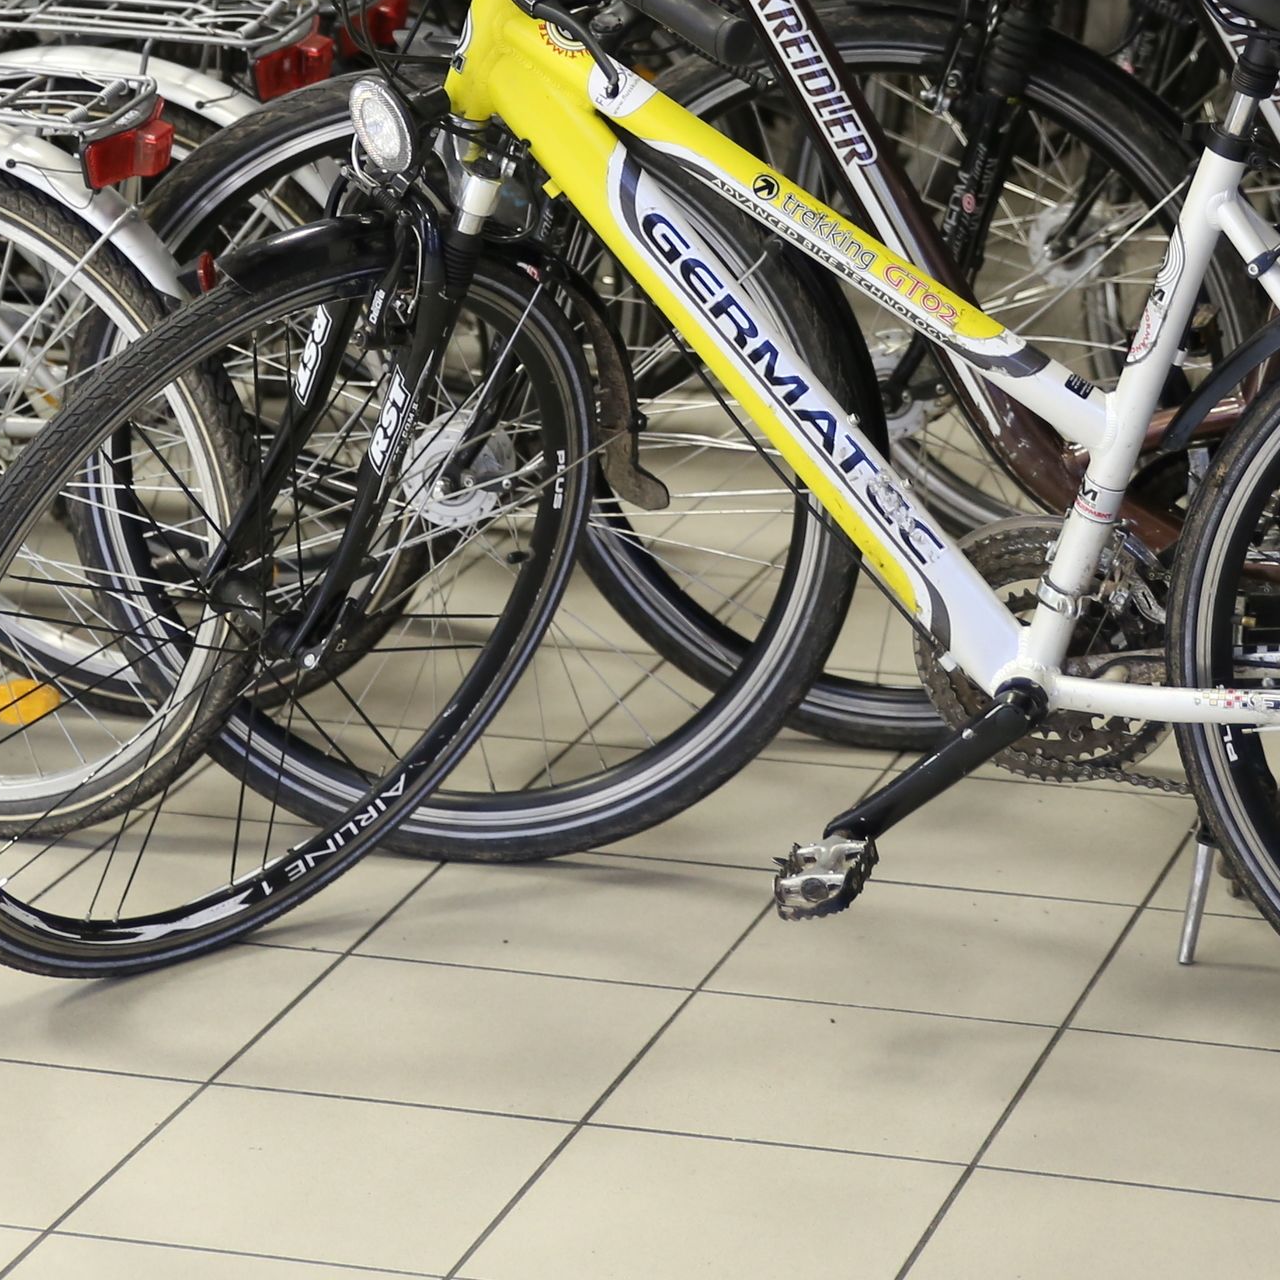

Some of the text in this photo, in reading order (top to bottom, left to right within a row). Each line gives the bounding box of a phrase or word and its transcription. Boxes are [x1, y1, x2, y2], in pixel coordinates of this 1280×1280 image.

[709, 178, 951, 344] ADVANCED BIKE TECHNOLOGY
[782, 192, 878, 272] trekking
[369, 365, 411, 475] RST
[552, 449, 566, 510] PLUS
[284, 773, 407, 882] AIRLINE
